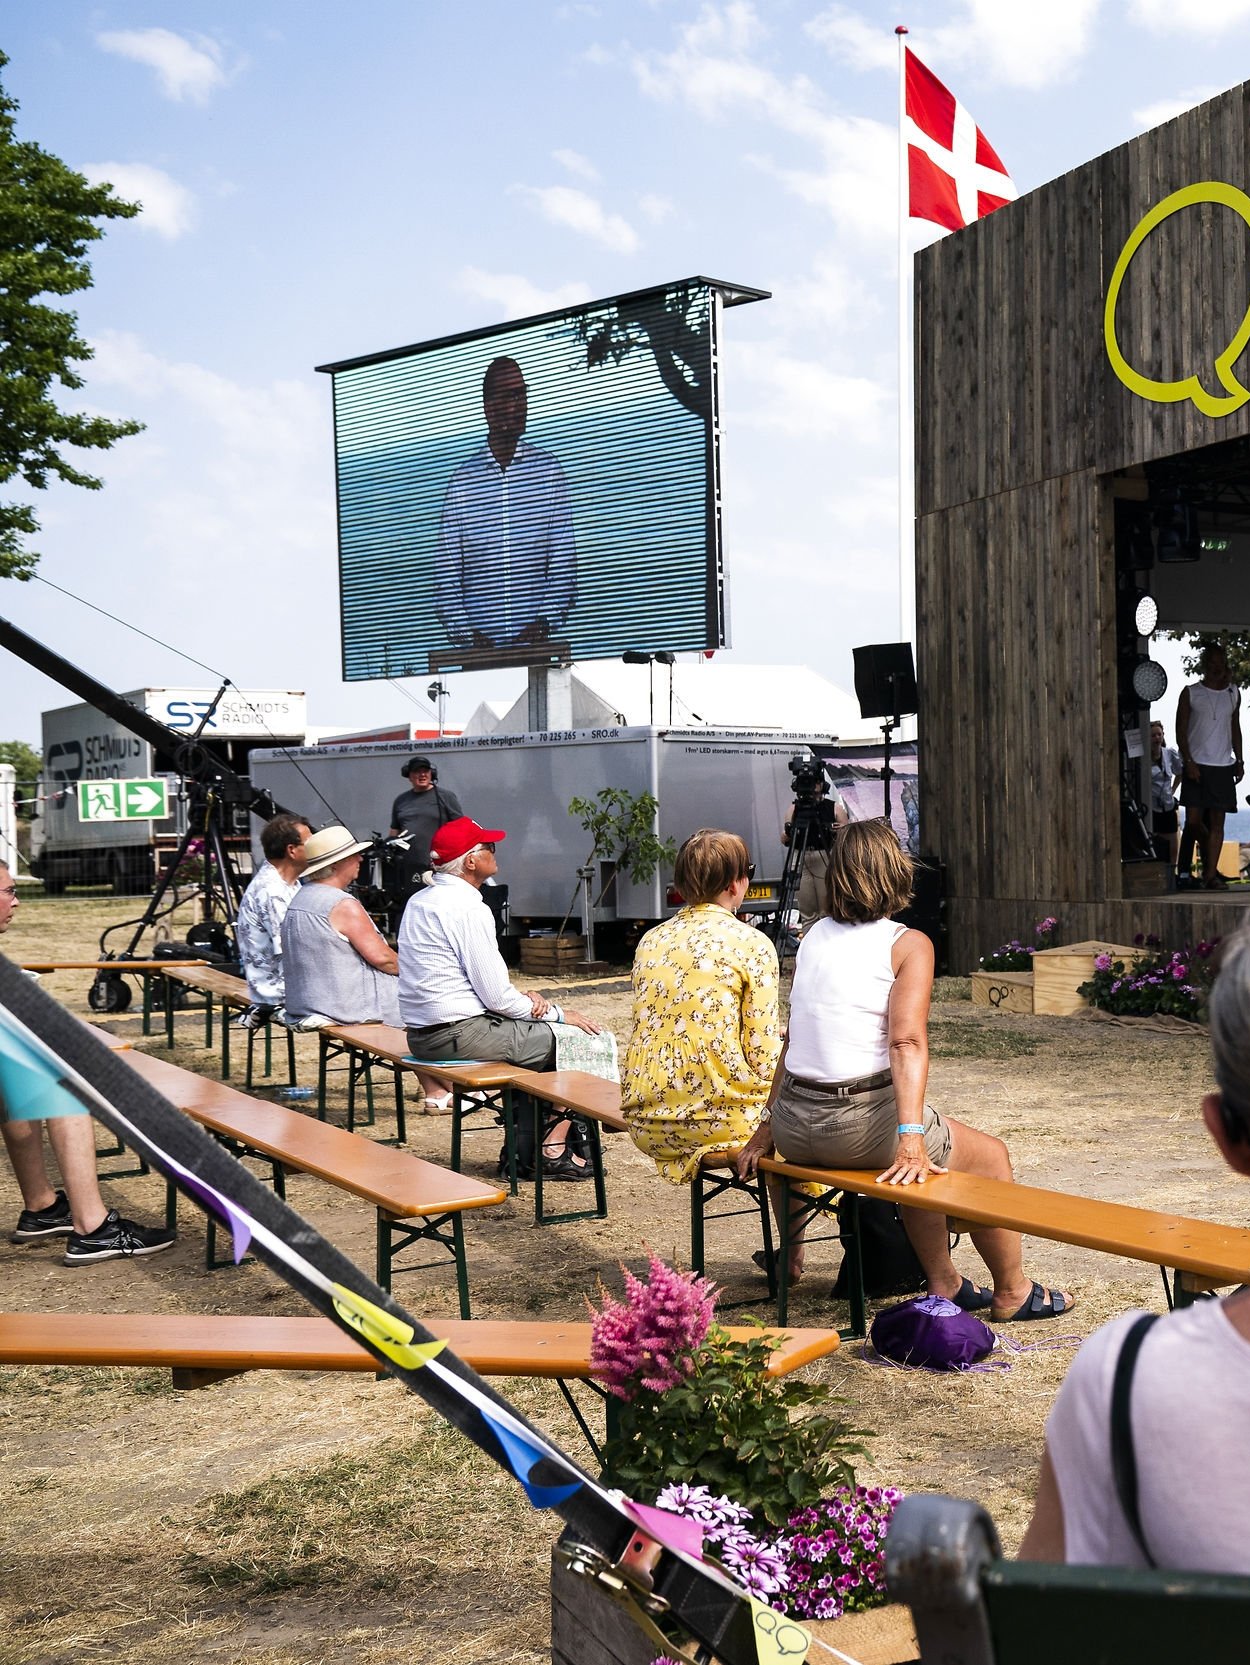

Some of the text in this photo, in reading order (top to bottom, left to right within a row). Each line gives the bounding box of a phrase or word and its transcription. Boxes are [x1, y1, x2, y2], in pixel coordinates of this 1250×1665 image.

[222, 702, 290, 713] SCHMIDTS
[222, 713, 264, 724] RADIO
[453, 738, 468, 747] 1937
[478, 737, 489, 746] det
[490, 735, 525, 747] forpligter!
[539, 733, 548, 741] 70
[549, 732, 561, 741] 225
[564, 731, 576, 740] 265
[591, 729, 620, 739] SRO.dk
